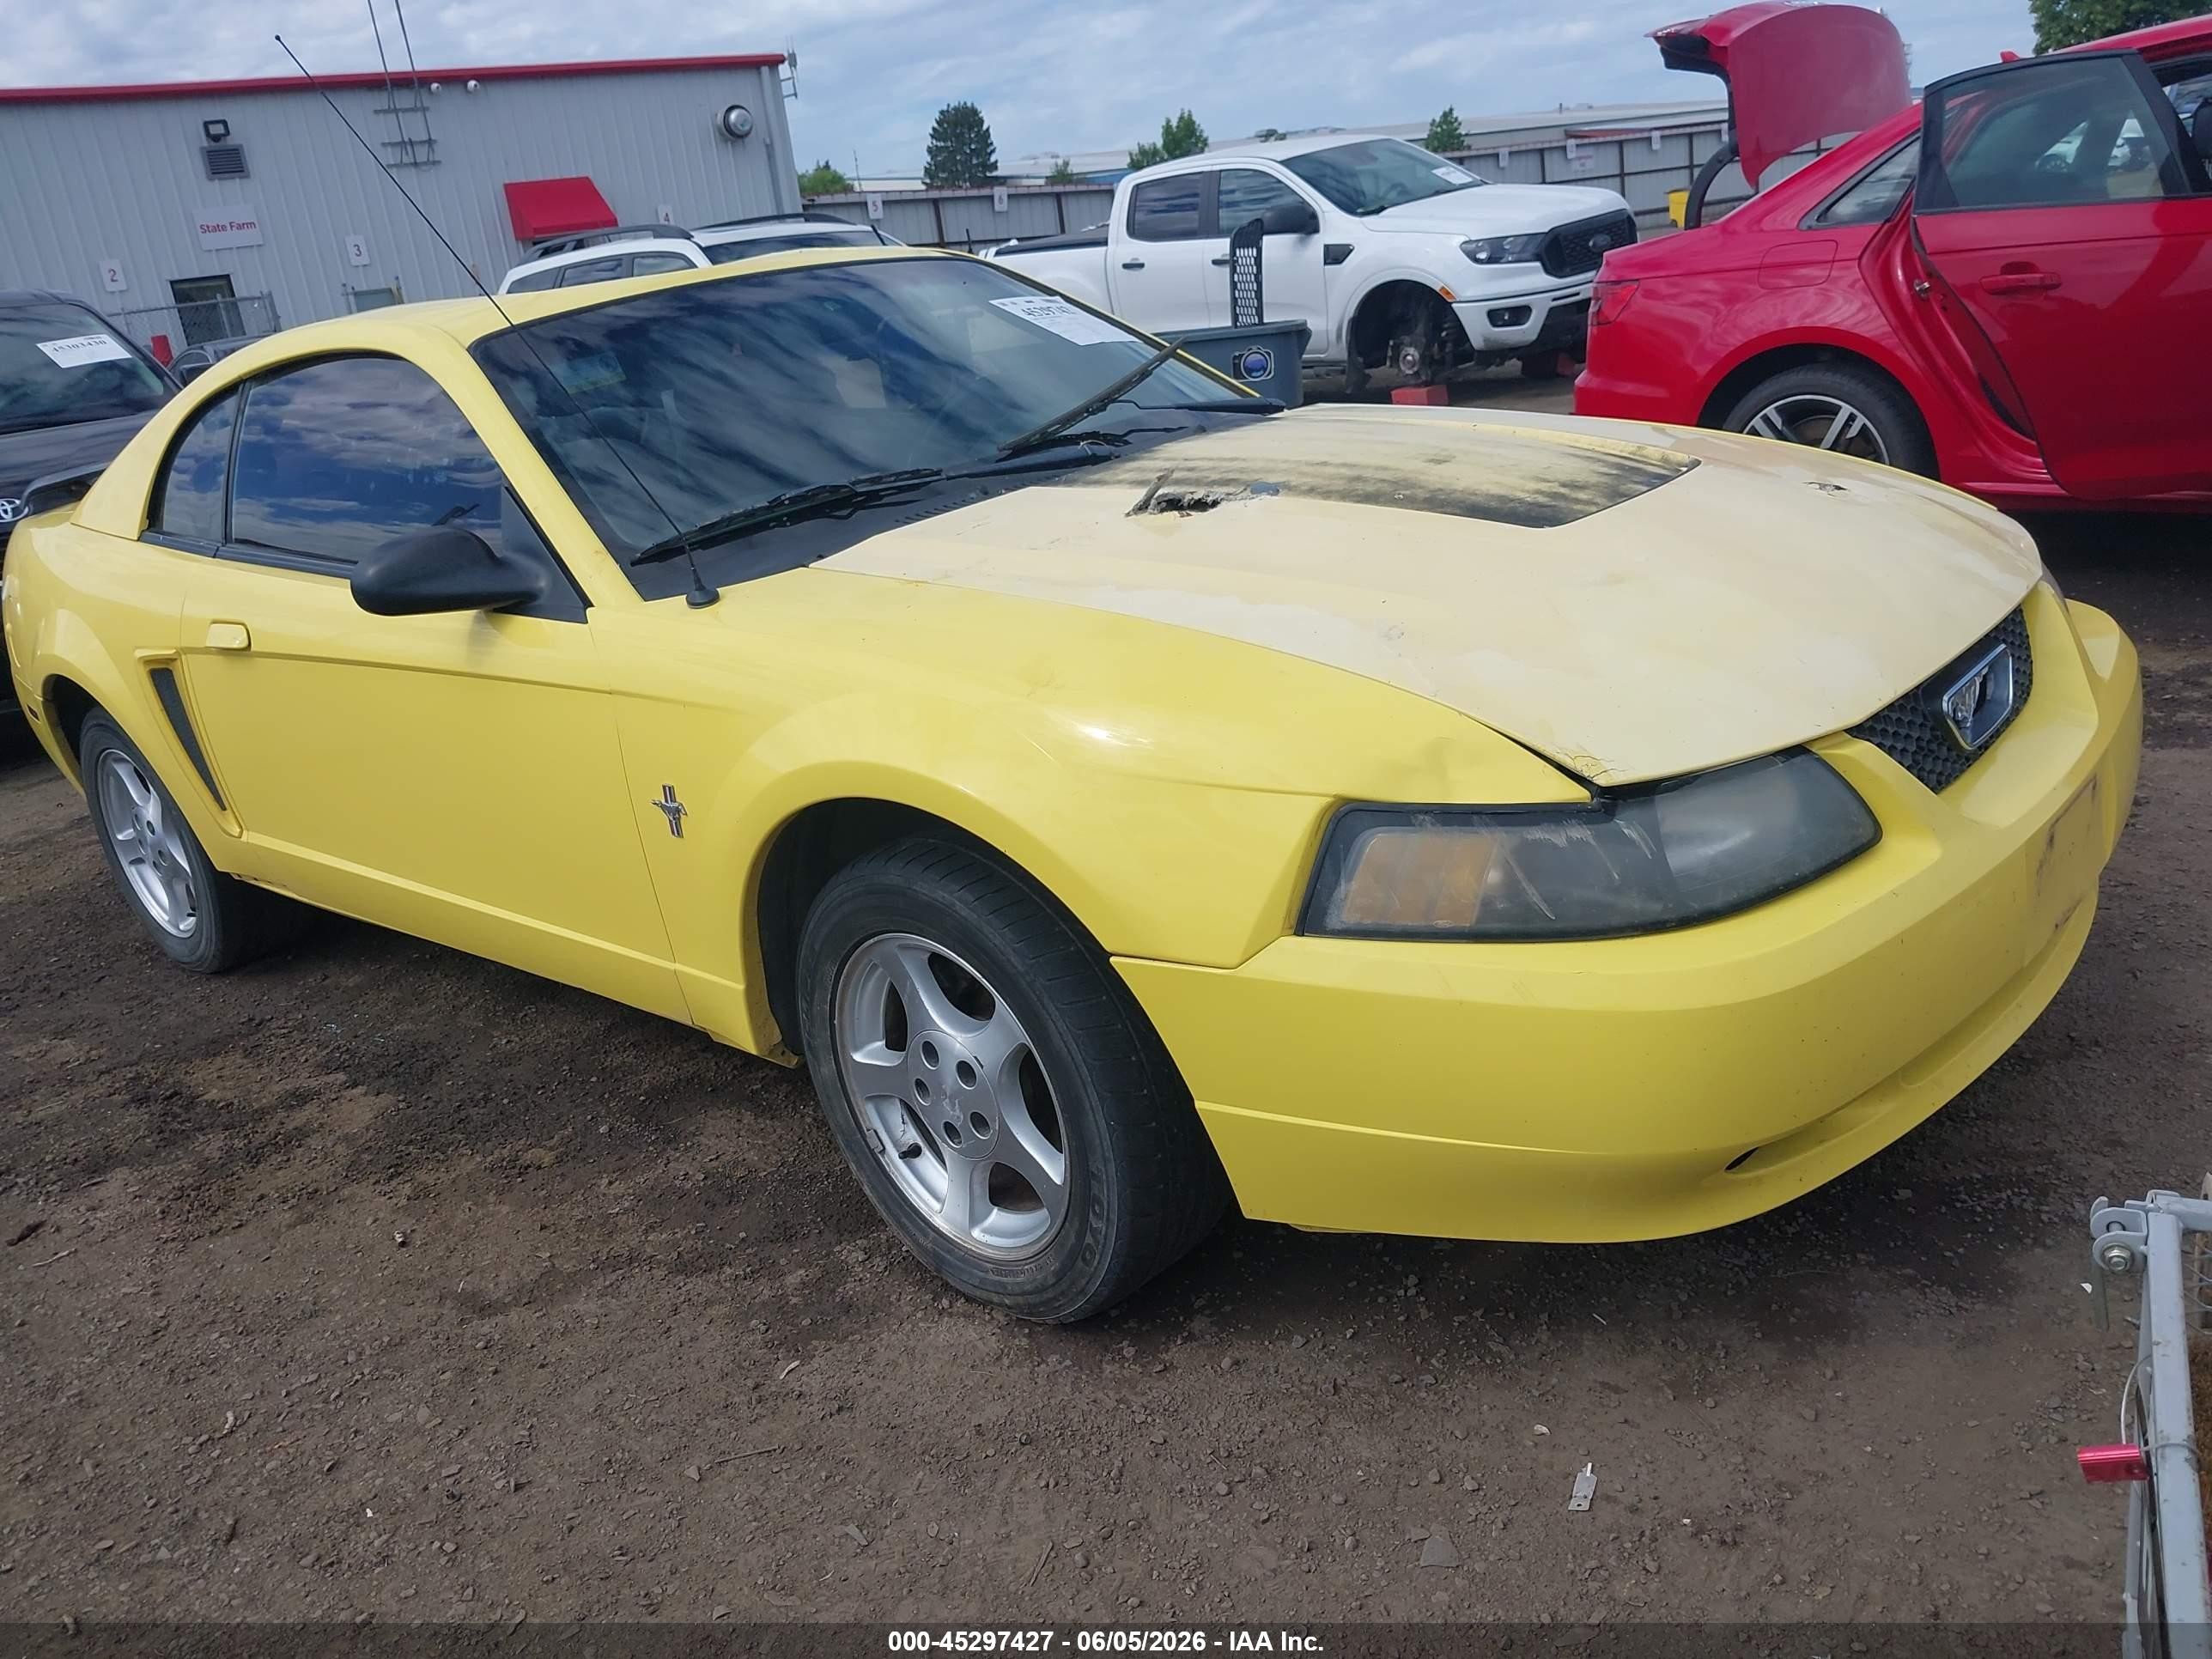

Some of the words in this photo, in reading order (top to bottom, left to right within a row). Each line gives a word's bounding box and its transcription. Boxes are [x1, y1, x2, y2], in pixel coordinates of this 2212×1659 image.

[872, 200, 879, 212] 5
[998, 194, 1004, 205] 6
[199, 222, 228, 234] State
[229, 220, 257, 231] Farm
[353, 244, 362, 257] 3
[108, 268, 118, 283] 2
